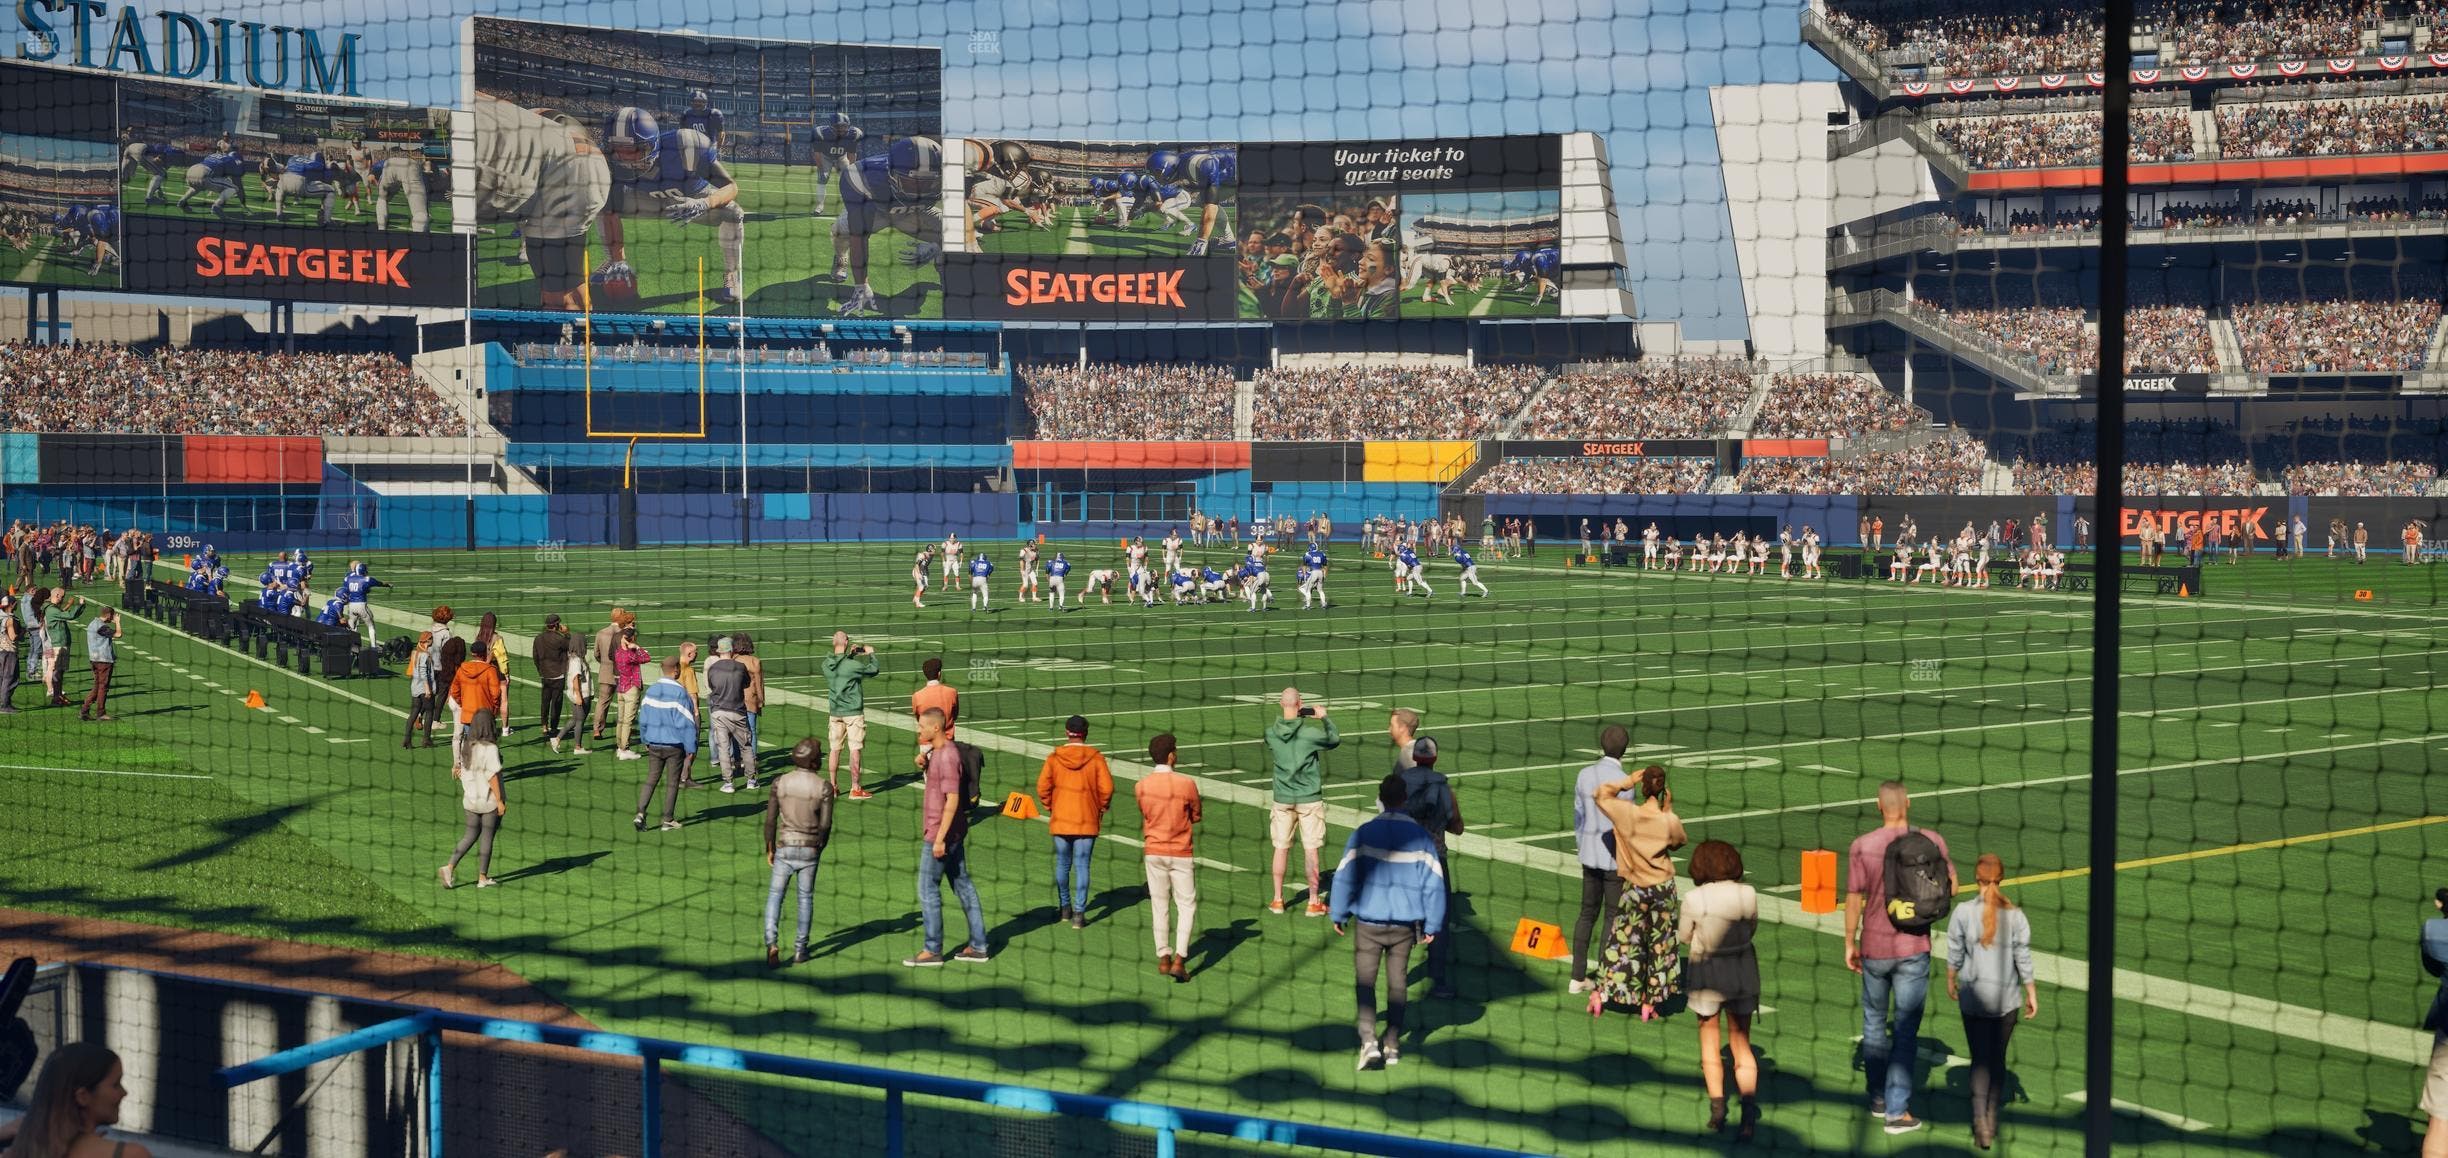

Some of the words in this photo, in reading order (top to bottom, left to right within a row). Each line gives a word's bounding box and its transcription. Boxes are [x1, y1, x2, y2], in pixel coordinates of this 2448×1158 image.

[16, 0, 362, 97] STADIUM
[1334, 149, 1380, 167] Your
[1385, 147, 1441, 163] ticket
[1446, 146, 1465, 162] to
[1345, 166, 1398, 186] great
[1402, 165, 1453, 181] seats
[196, 236, 411, 289] SEATGEEK
[1006, 268, 1187, 308] SEATGEEK
[2123, 376, 2177, 392] ATGEEK
[1583, 442, 1644, 456] SEATGEEK
[2120, 506, 2269, 540] EATGEEK
[1010, 796, 1023, 813] 10
[1527, 926, 1541, 949] G
